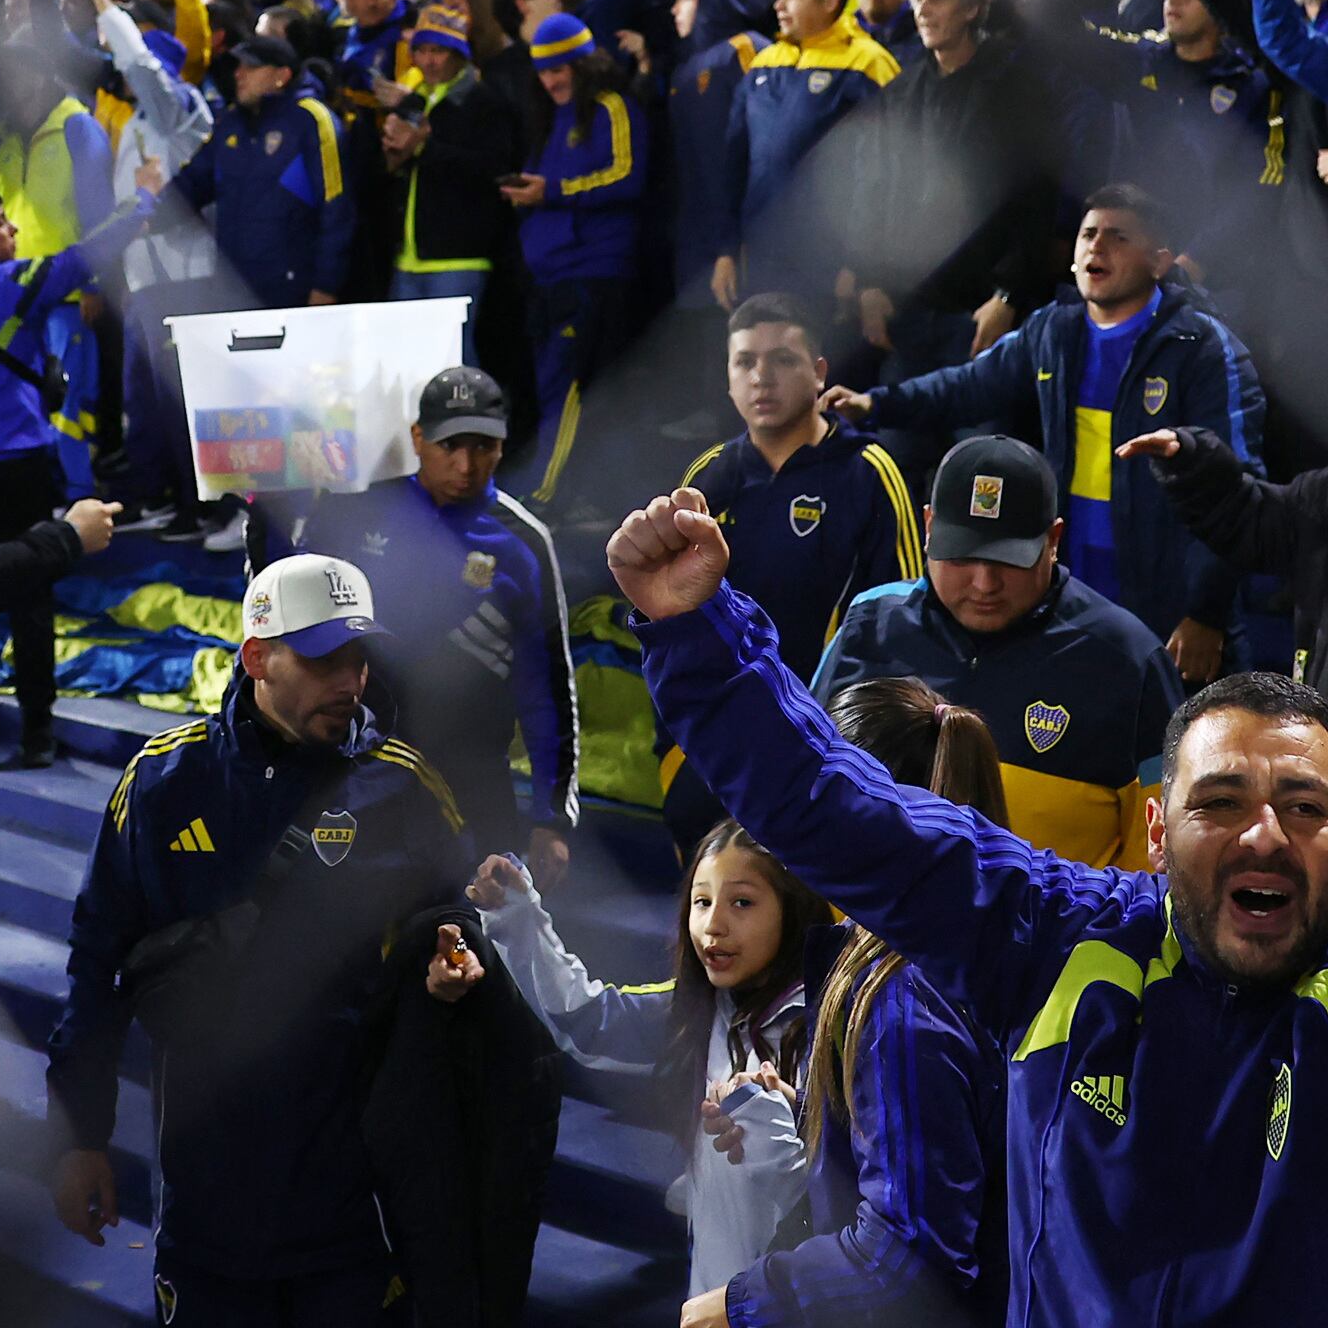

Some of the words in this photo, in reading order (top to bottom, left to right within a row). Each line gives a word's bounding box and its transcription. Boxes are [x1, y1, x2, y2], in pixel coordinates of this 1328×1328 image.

[325, 568, 358, 606] LA
[1029, 716, 1062, 733] CABJ
[317, 830, 350, 841] CABJ
[1071, 1080, 1127, 1126] adidas
